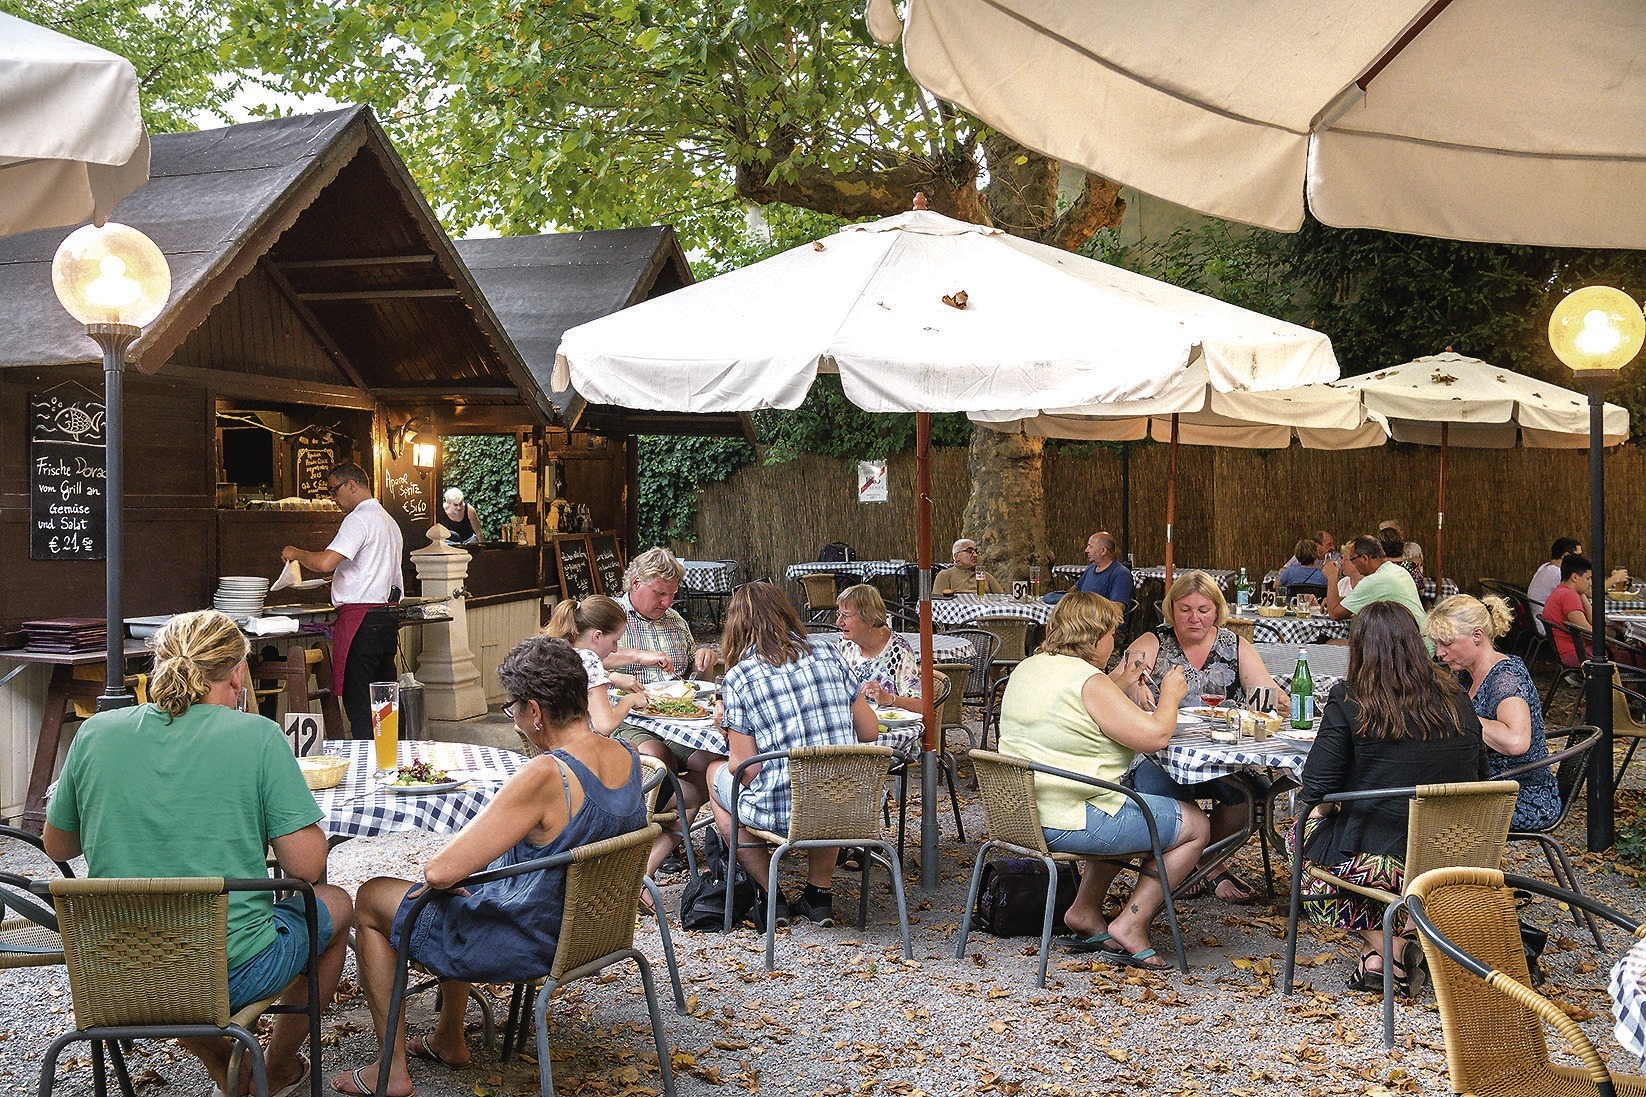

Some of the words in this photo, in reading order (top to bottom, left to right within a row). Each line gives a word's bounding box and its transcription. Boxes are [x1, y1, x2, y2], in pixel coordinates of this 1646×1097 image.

[36, 456, 72, 477] Frische
[38, 484, 57, 494] vom
[60, 479, 82, 501] Grill
[86, 486, 101, 496] an
[385, 467, 409, 500] Aperol
[49, 502, 90, 515] Gemüse
[38, 518, 56, 530] und
[60, 515, 88, 531] Salat
[285, 716, 318, 759] 12
